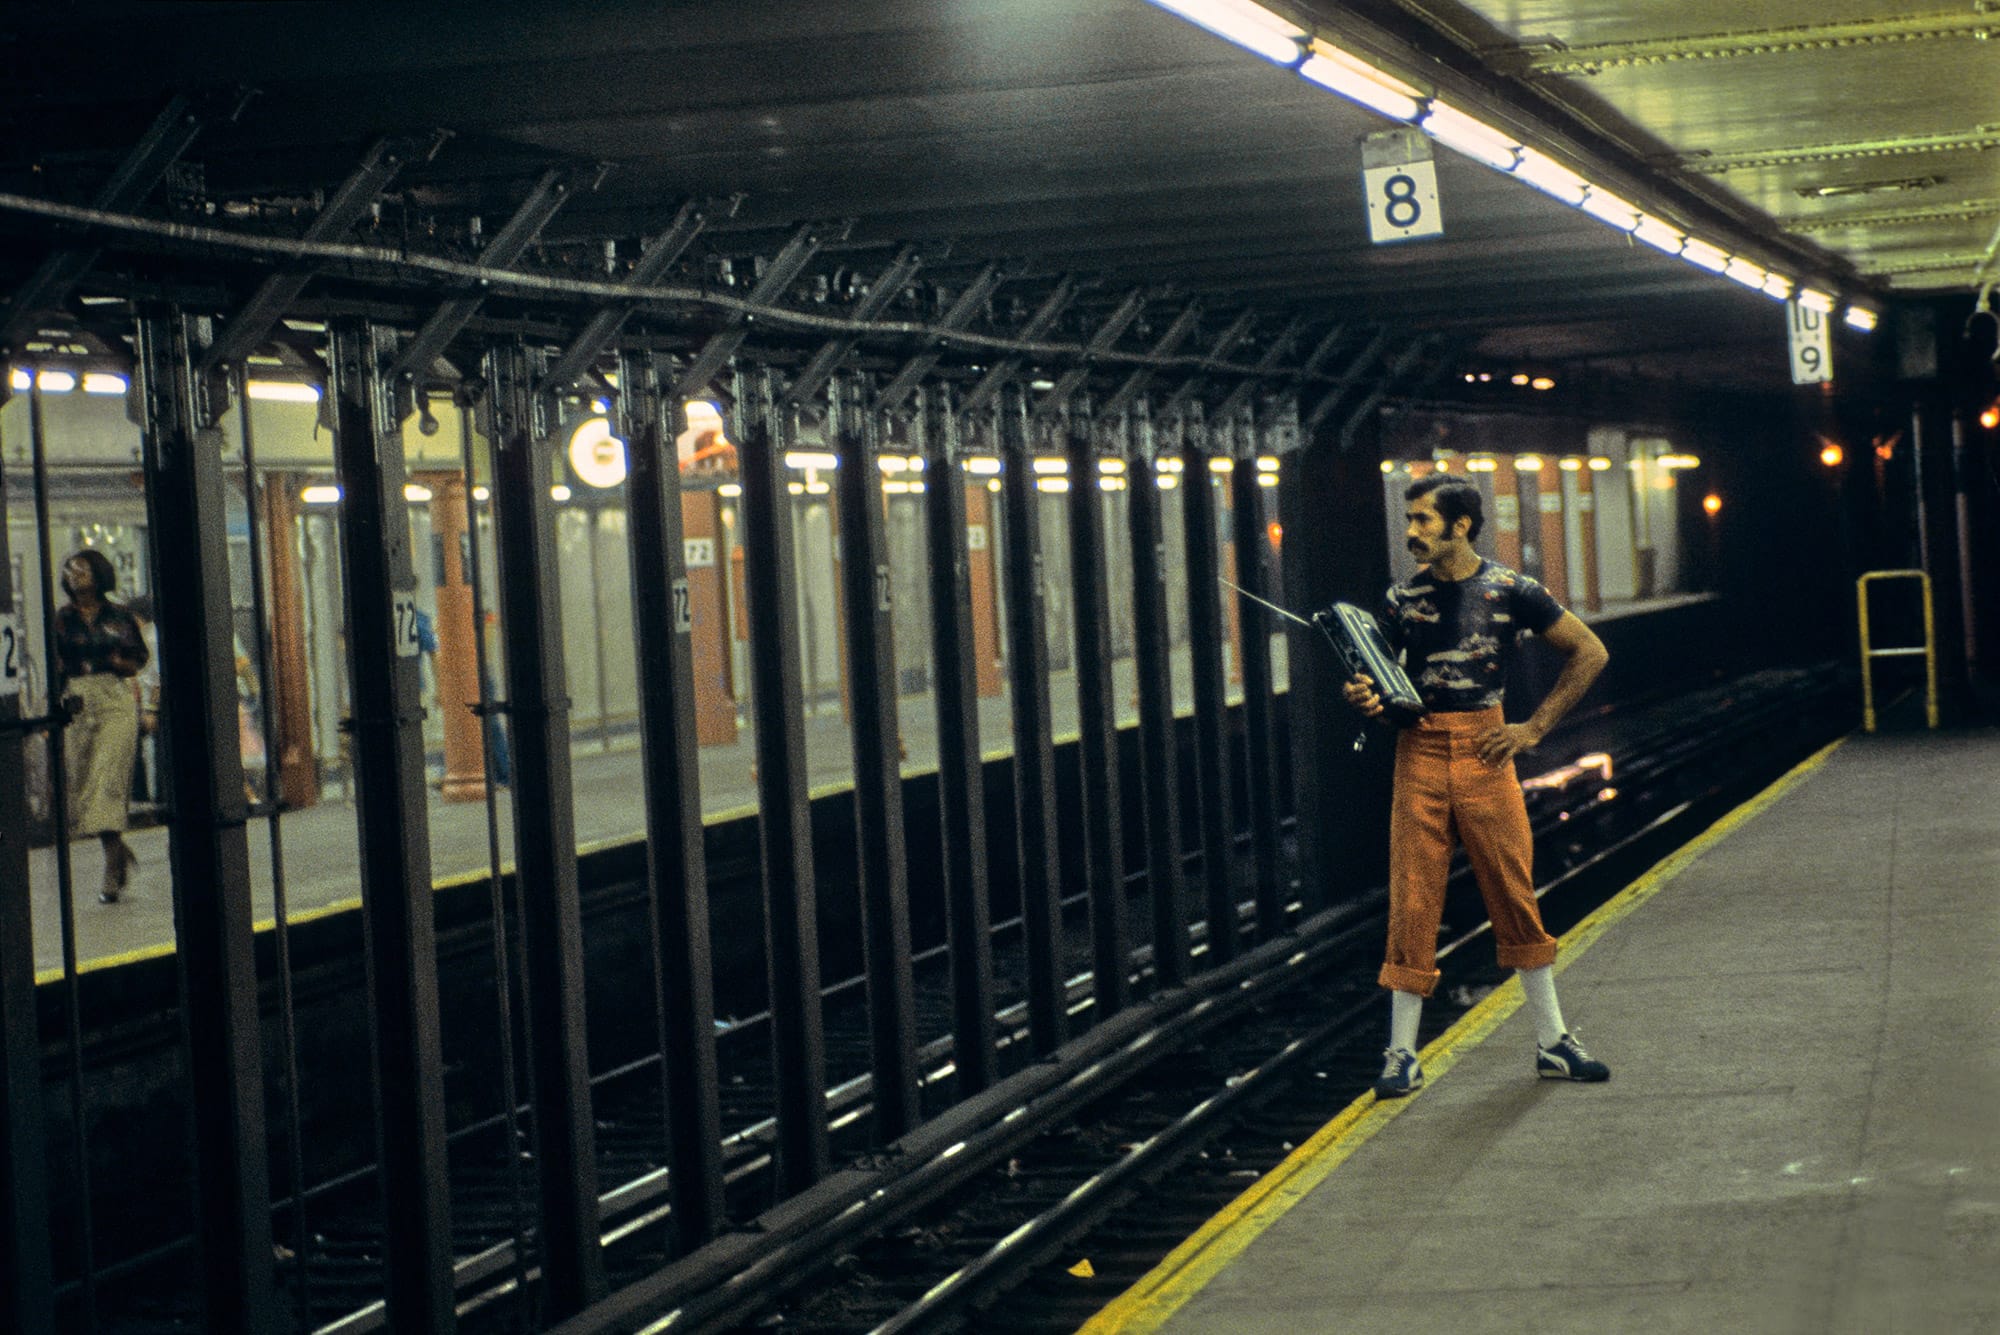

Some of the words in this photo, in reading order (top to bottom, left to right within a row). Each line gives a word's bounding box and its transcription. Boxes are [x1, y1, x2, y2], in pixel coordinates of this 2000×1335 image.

[1384, 174, 1421, 228] 8
[1801, 346, 1821, 373] 9
[396, 601, 417, 645] 72
[675, 588, 690, 624] 72
